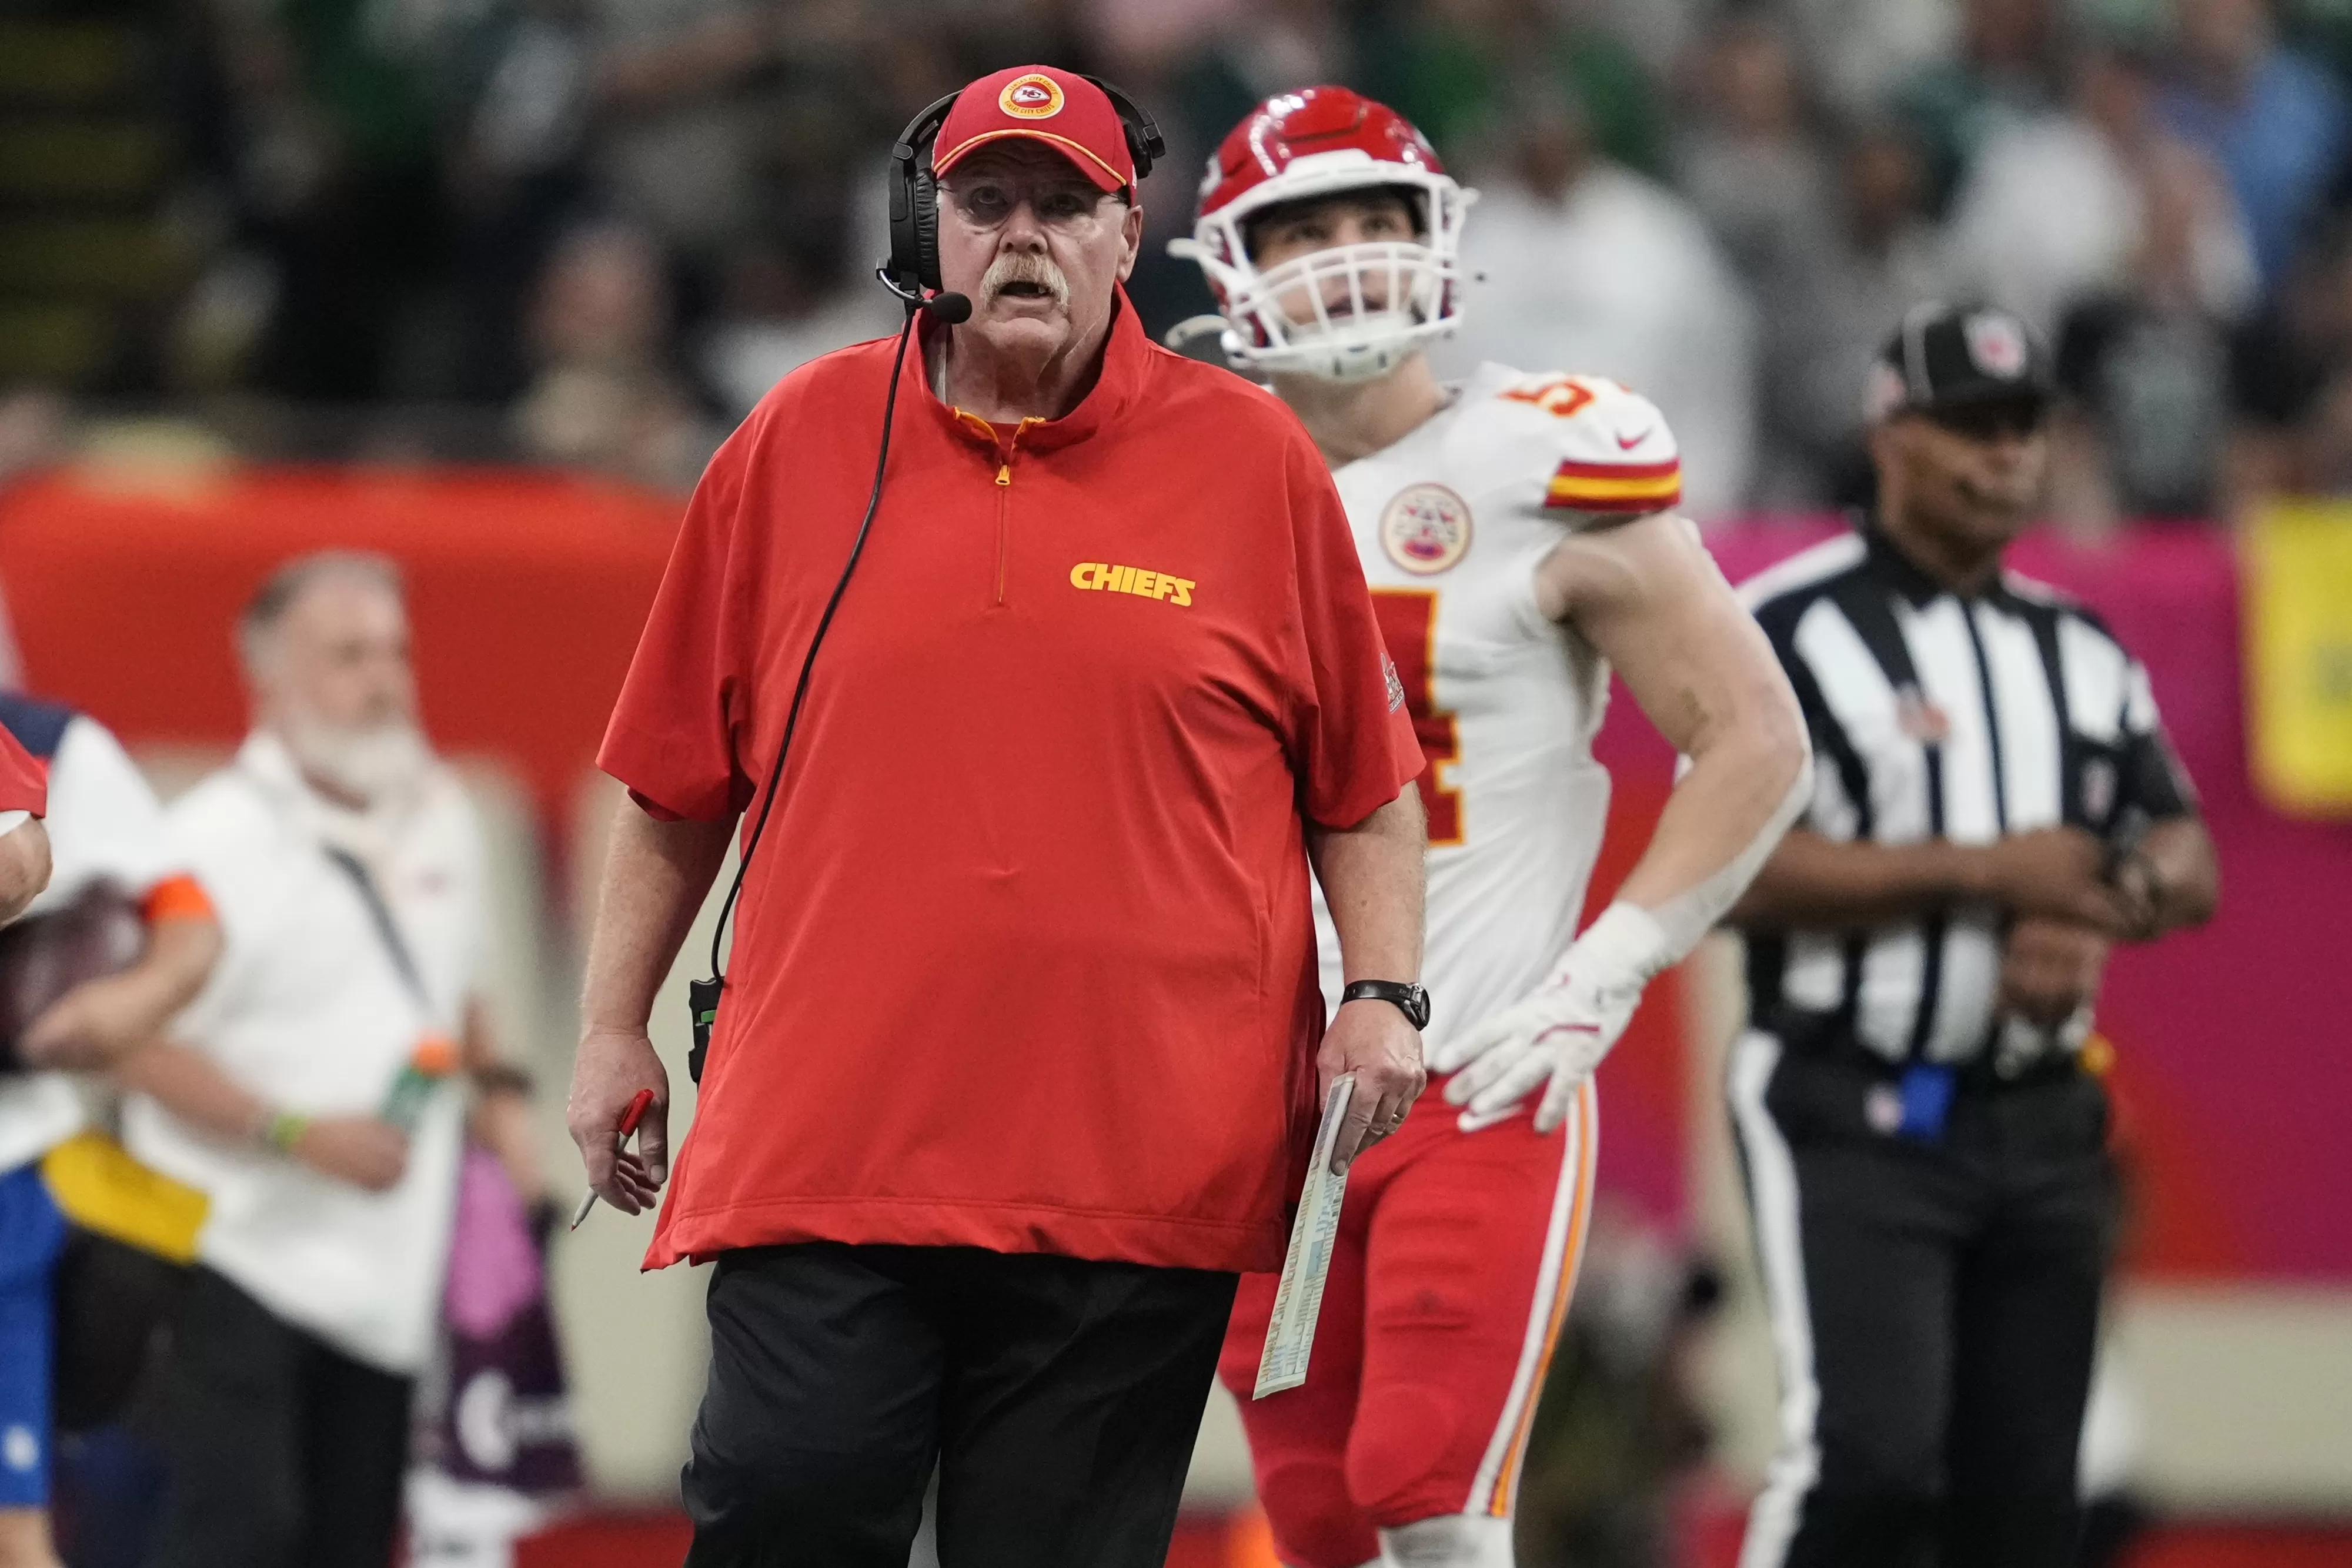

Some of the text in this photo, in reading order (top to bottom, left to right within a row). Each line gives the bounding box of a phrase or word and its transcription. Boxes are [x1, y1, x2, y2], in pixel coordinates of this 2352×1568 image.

[1035, 103, 1055, 114] CHIEFS
[1492, 376, 1632, 418] 5
[1070, 563, 1196, 607] CHIEFS
